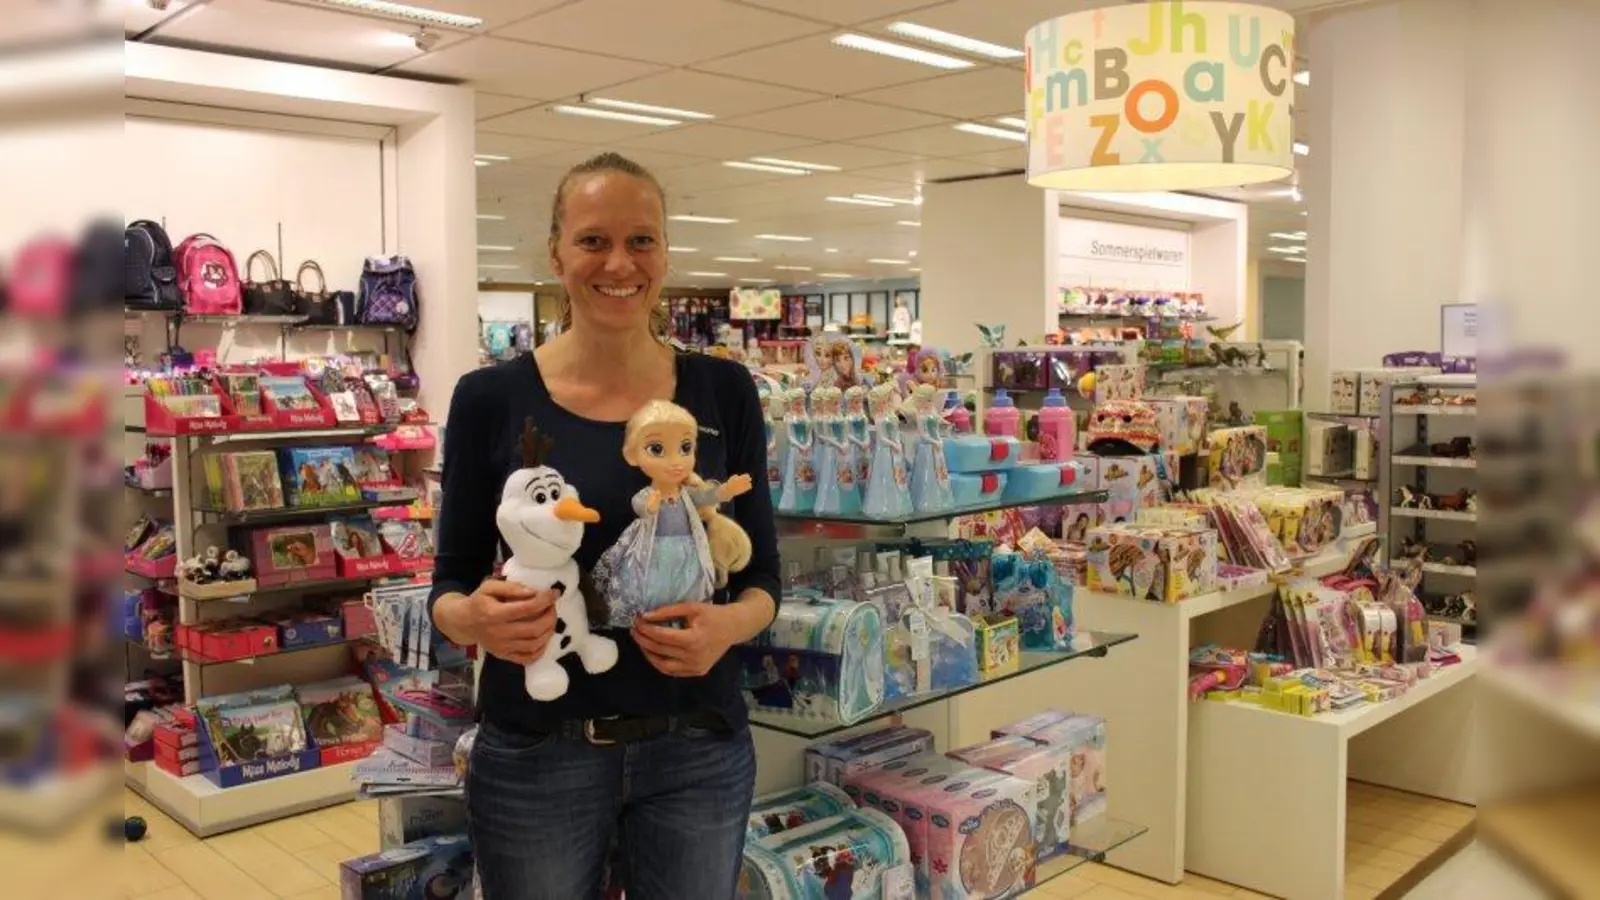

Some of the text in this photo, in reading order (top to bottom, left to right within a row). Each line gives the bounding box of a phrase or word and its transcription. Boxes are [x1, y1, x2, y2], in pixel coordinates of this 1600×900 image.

[1034, 19, 1060, 74] H
[1127, 1, 1162, 55] J
[1171, 0, 1206, 53] h
[1229, 15, 1260, 67] U
[1046, 67, 1088, 112] m
[1094, 47, 1130, 100] B
[1183, 60, 1224, 102] a
[1209, 112, 1245, 163] Y
[1247, 100, 1275, 152] K
